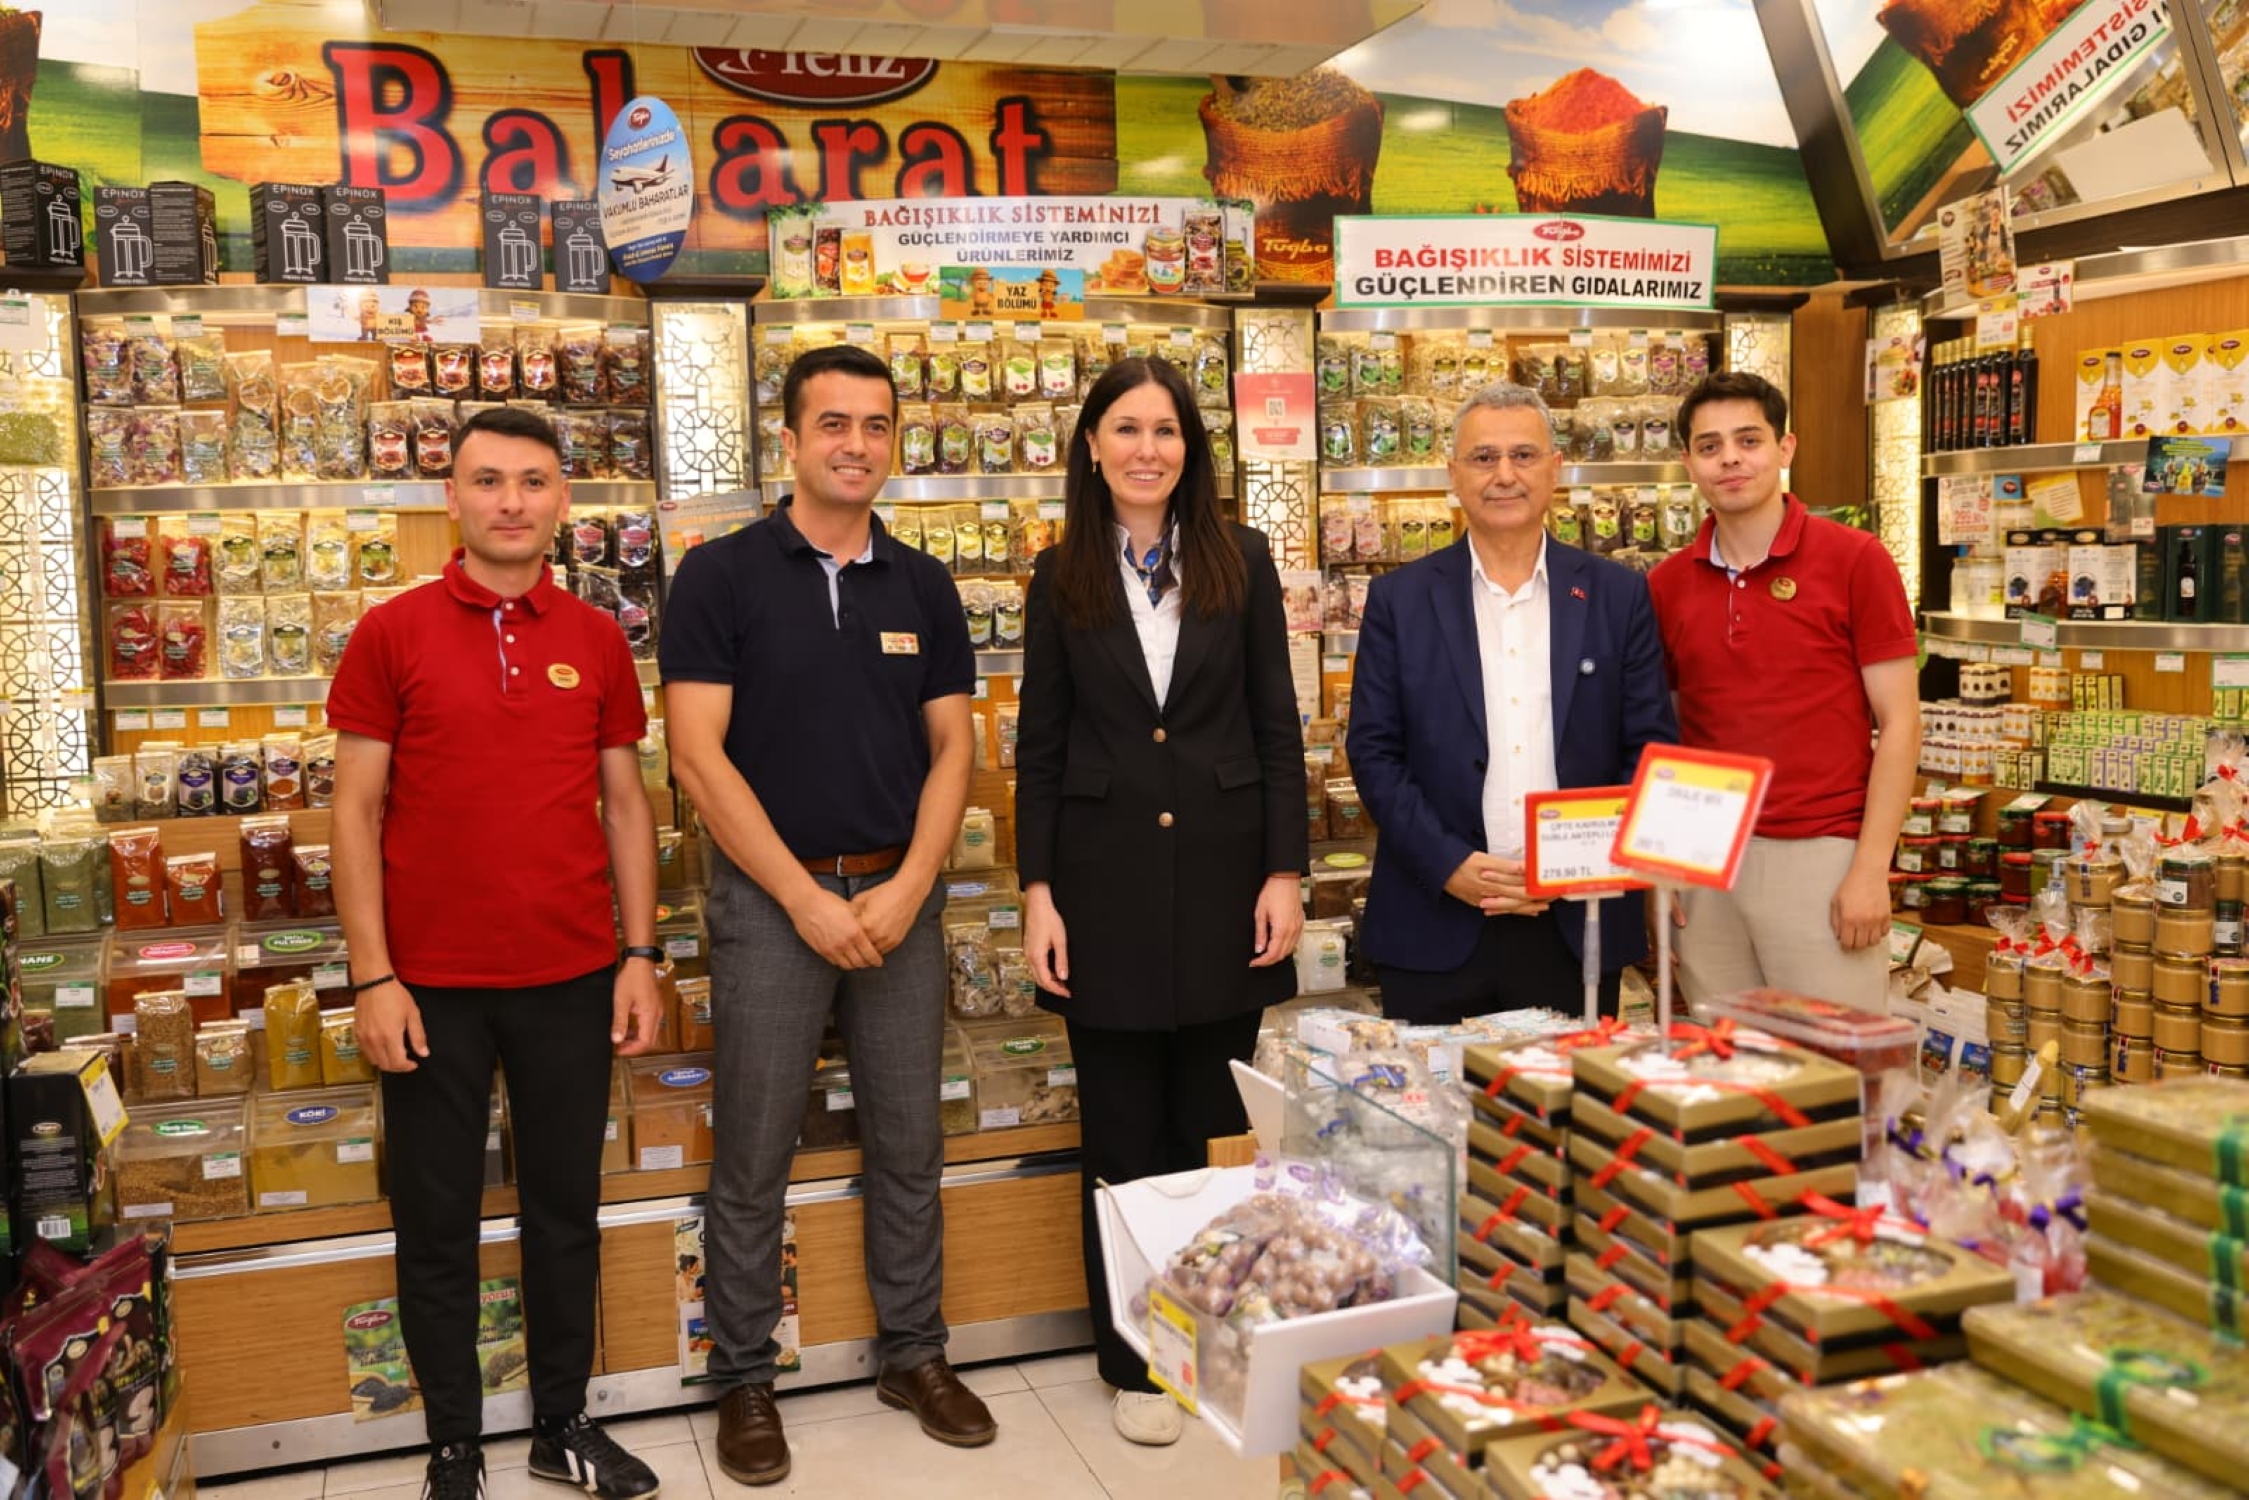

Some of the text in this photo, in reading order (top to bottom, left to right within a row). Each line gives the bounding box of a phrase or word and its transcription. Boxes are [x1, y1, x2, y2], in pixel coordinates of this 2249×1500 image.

[864, 201, 1161, 229] BAĞIŞIKLIK SİSTEMİNİZİ
[897, 229, 1130, 247] GÜÇLENDİRMEYE YARDIMCI
[956, 247, 1075, 263] ÜRÜNLERİMİZ
[1374, 244, 1692, 273] BAĞIŞIKLIK SİSTEMİMİZİ
[1006, 285, 1028, 298] YAZ
[1354, 271, 1703, 300] GÜÇLENDİREN GIDALARIMIZ
[996, 297, 1037, 311] BÖLÜMÜ
